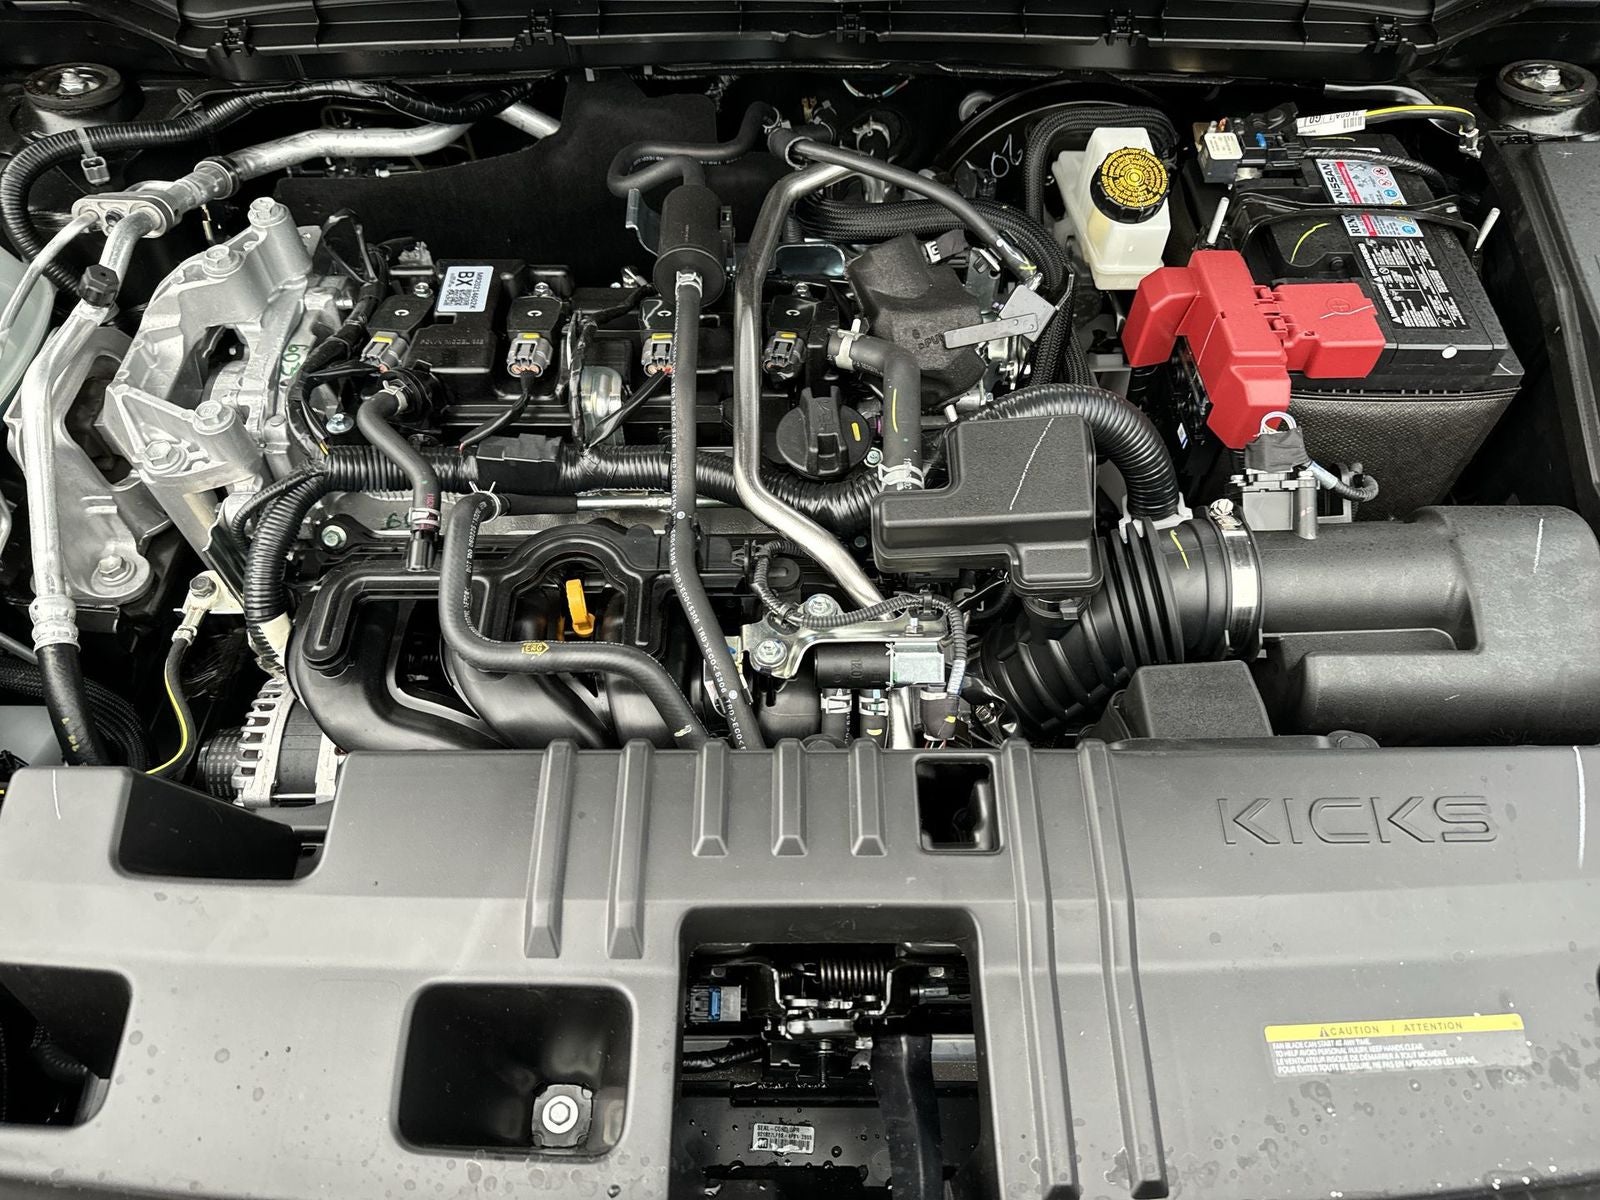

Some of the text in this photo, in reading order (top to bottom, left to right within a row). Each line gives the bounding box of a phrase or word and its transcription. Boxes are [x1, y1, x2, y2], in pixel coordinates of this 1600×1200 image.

[1321, 164, 1345, 199] NISSAN
[456, 271, 475, 286] BX
[1217, 796, 1498, 844] KICKS
[1330, 1025, 1379, 1035] CAUTION
[1404, 1021, 1462, 1031] ATTENTION
